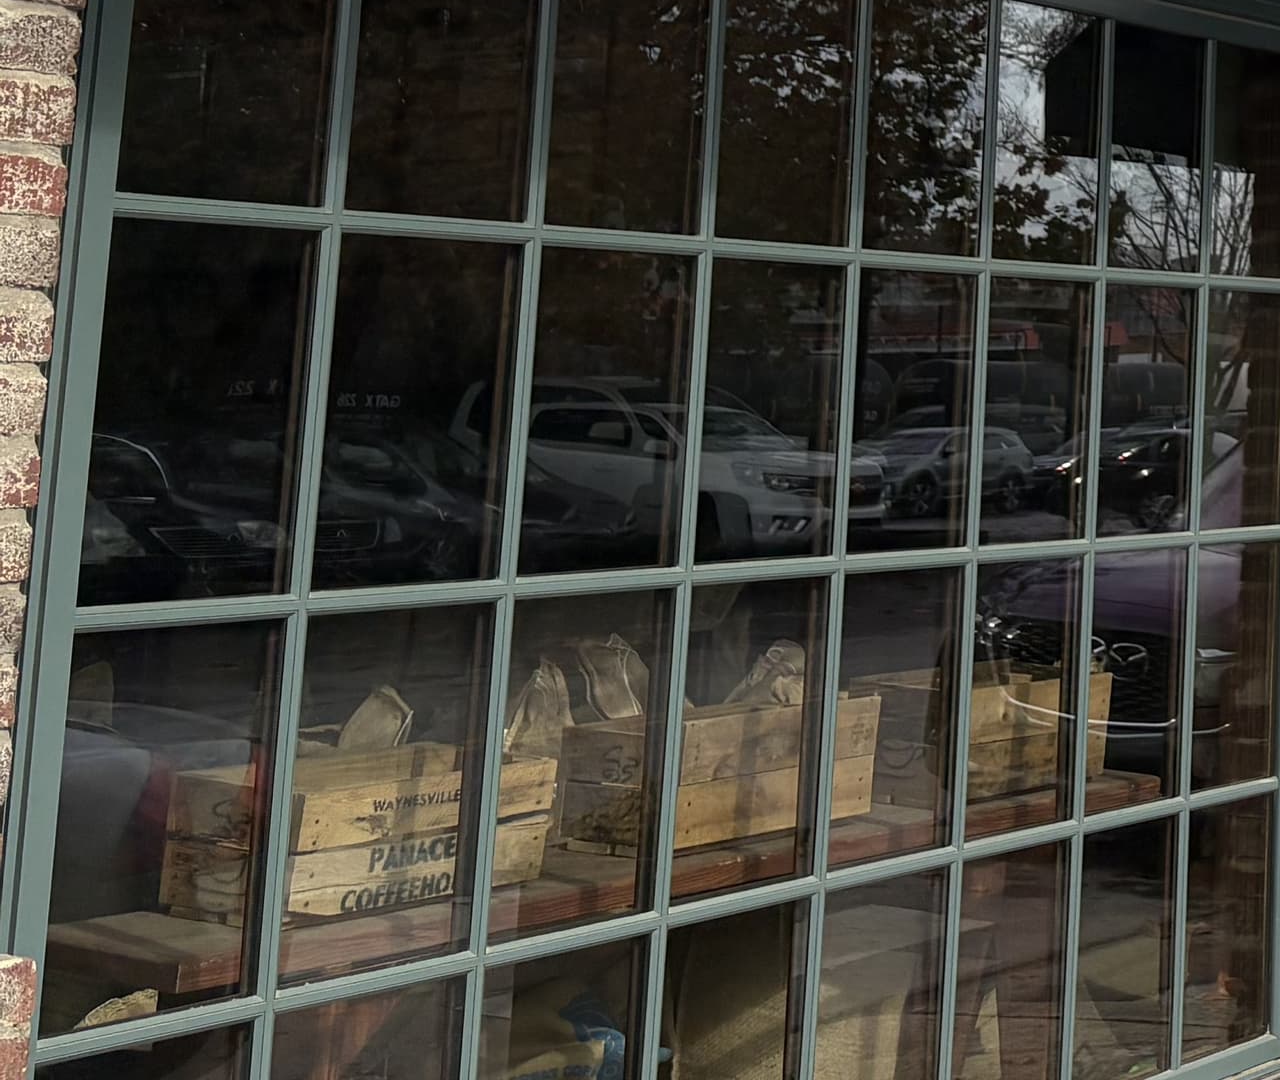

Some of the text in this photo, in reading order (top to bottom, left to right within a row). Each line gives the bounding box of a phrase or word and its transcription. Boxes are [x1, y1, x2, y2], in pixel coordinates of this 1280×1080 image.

[372, 788, 461, 813] WAYNESVILLE
[367, 834, 457, 874] PANACE
[340, 871, 453, 912] COFFEEHO
